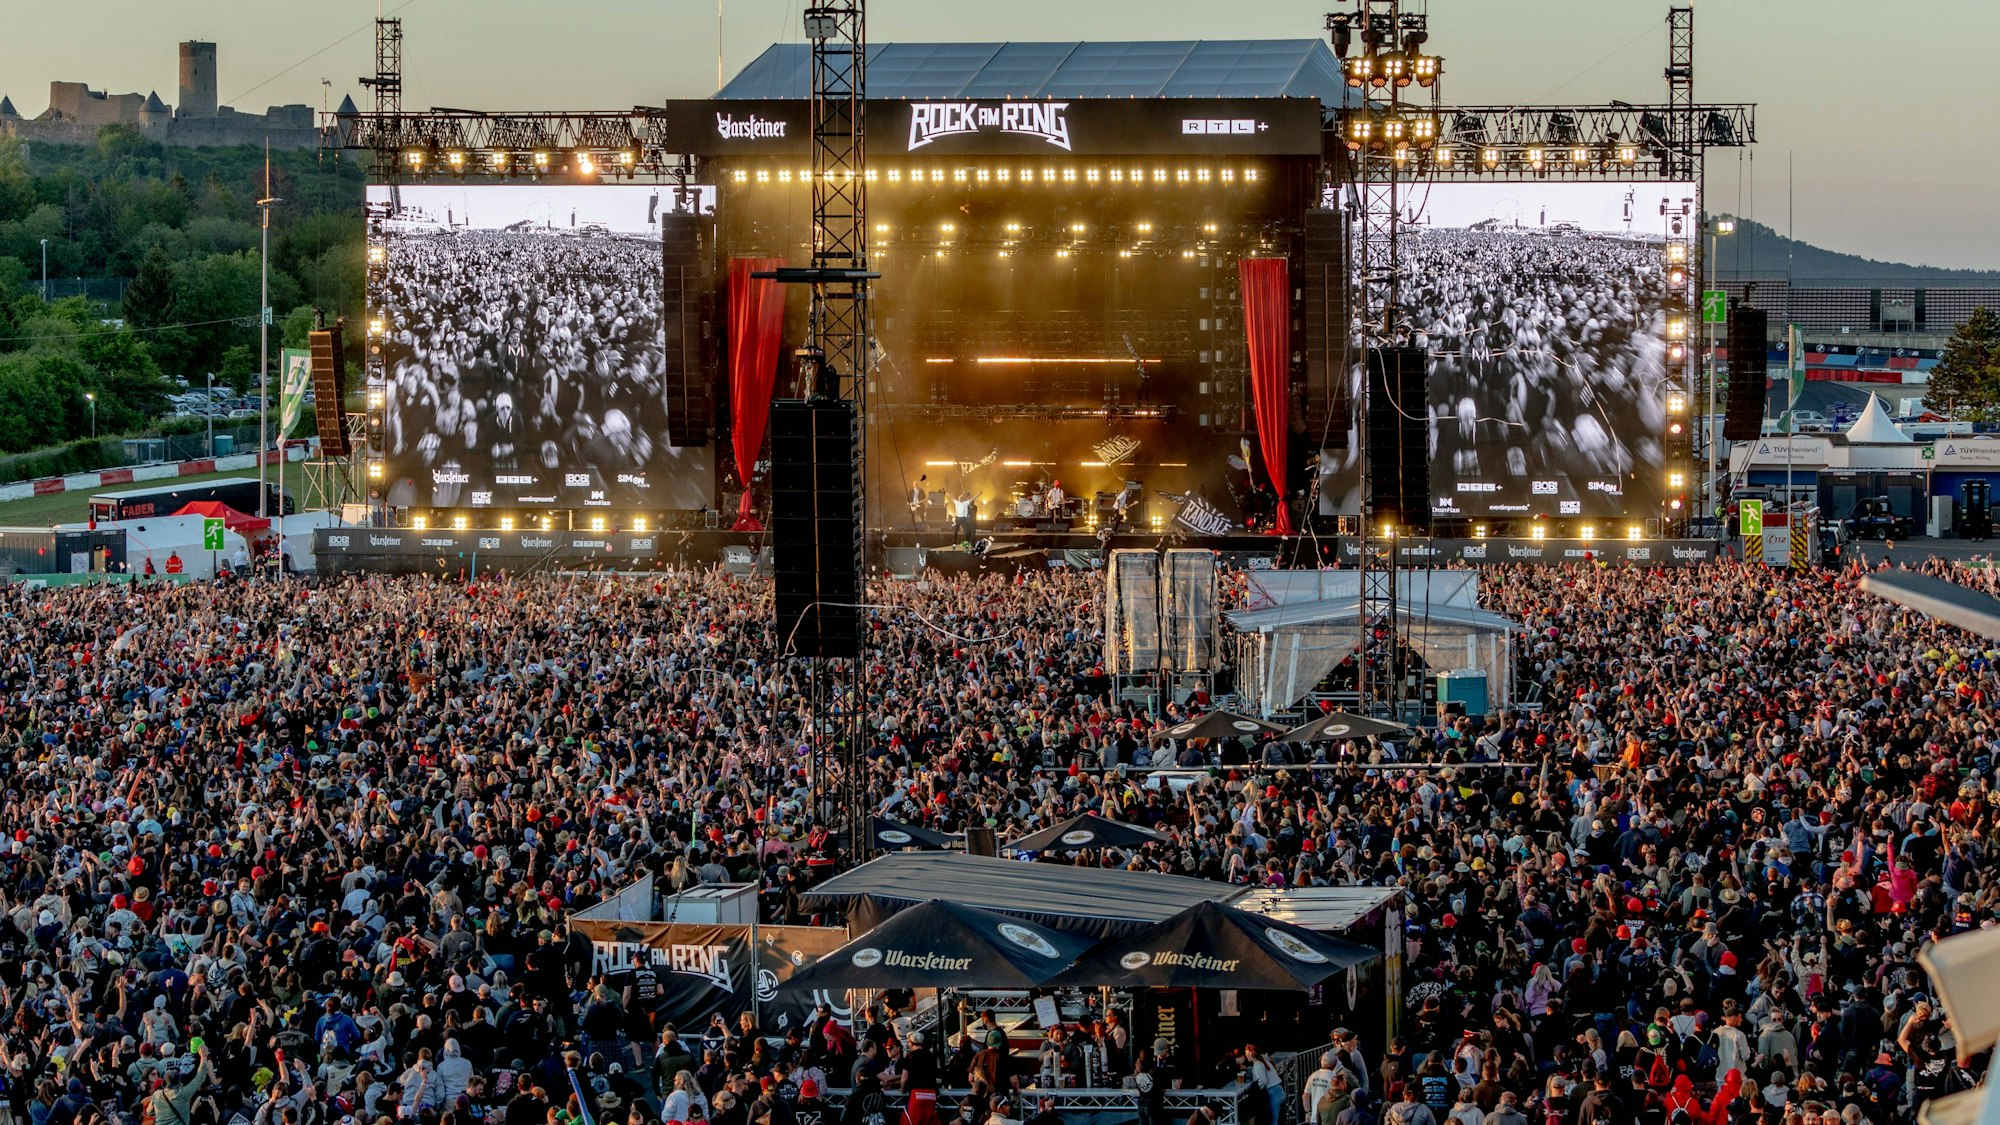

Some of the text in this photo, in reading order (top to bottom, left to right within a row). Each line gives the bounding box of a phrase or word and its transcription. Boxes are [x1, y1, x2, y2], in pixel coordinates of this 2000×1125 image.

[716, 111, 787, 139] Warsteiner
[908, 103, 1072, 151] ROCK AM RING
[1184, 119, 1269, 134] RTL+
[1773, 445, 1818, 453] TÜVheinland
[1458, 483, 1503, 491] RTL+
[122, 502, 155, 517] FABER
[1181, 499, 1233, 536] RANDALE
[651, 948, 670, 966] AM
[671, 944, 734, 993] RING
[884, 948, 973, 971] Warsteiner
[1152, 950, 1240, 972] Warsteiner
